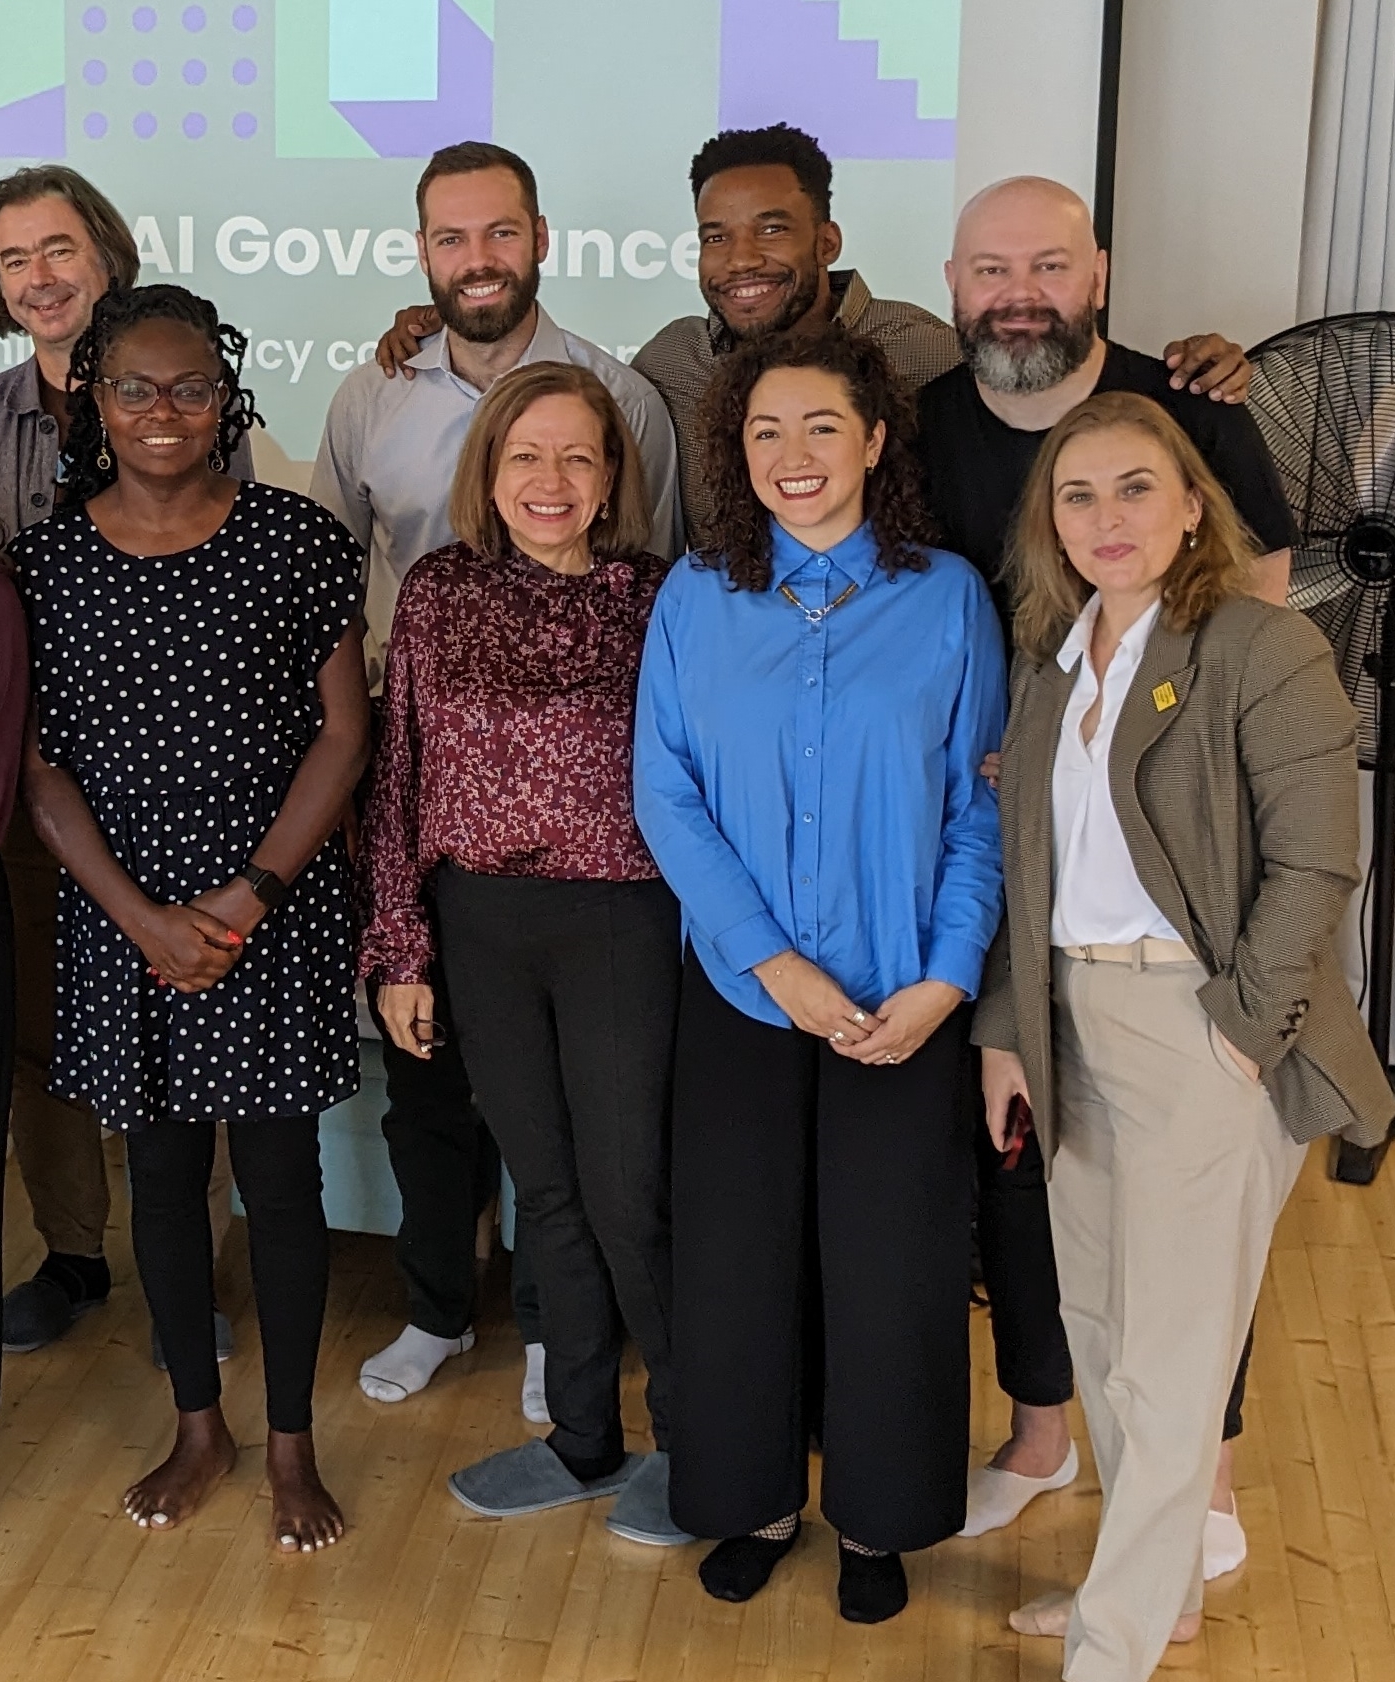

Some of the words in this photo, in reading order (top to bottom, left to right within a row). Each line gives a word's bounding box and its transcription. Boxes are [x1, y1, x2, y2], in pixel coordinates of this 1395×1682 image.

[132, 215, 194, 274] AI
[215, 216, 699, 279] Govence
[229, 328, 315, 383] icy
